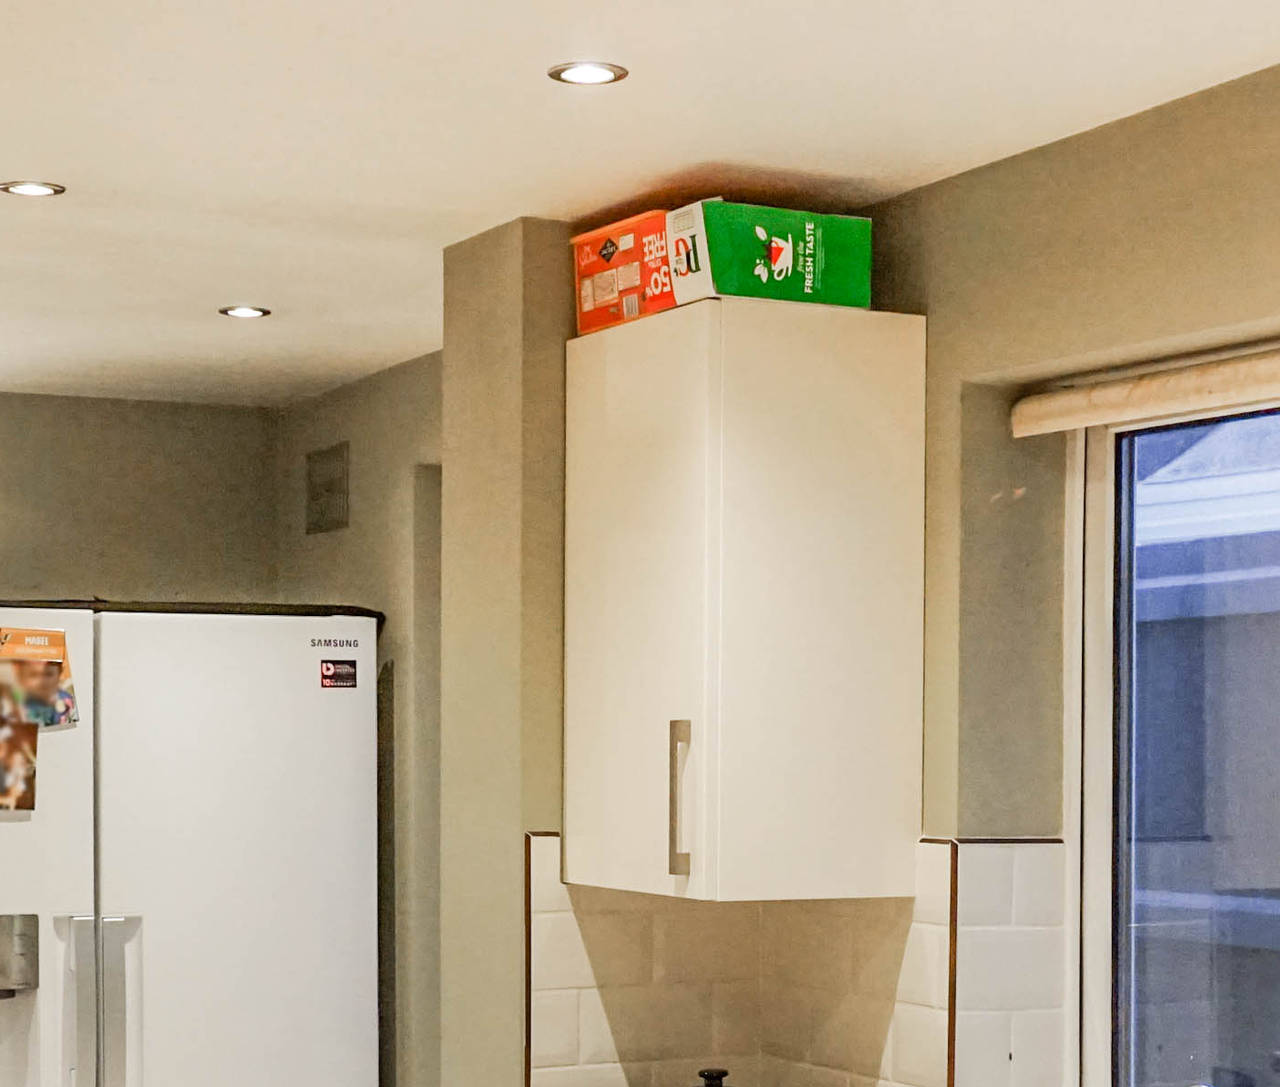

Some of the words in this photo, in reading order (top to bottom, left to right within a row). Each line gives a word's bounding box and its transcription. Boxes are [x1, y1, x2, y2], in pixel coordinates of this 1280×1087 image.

[805, 221, 815, 255] TASTE
[804, 257, 814, 294] FRESH
[311, 639, 359, 648] SAMSUNG
